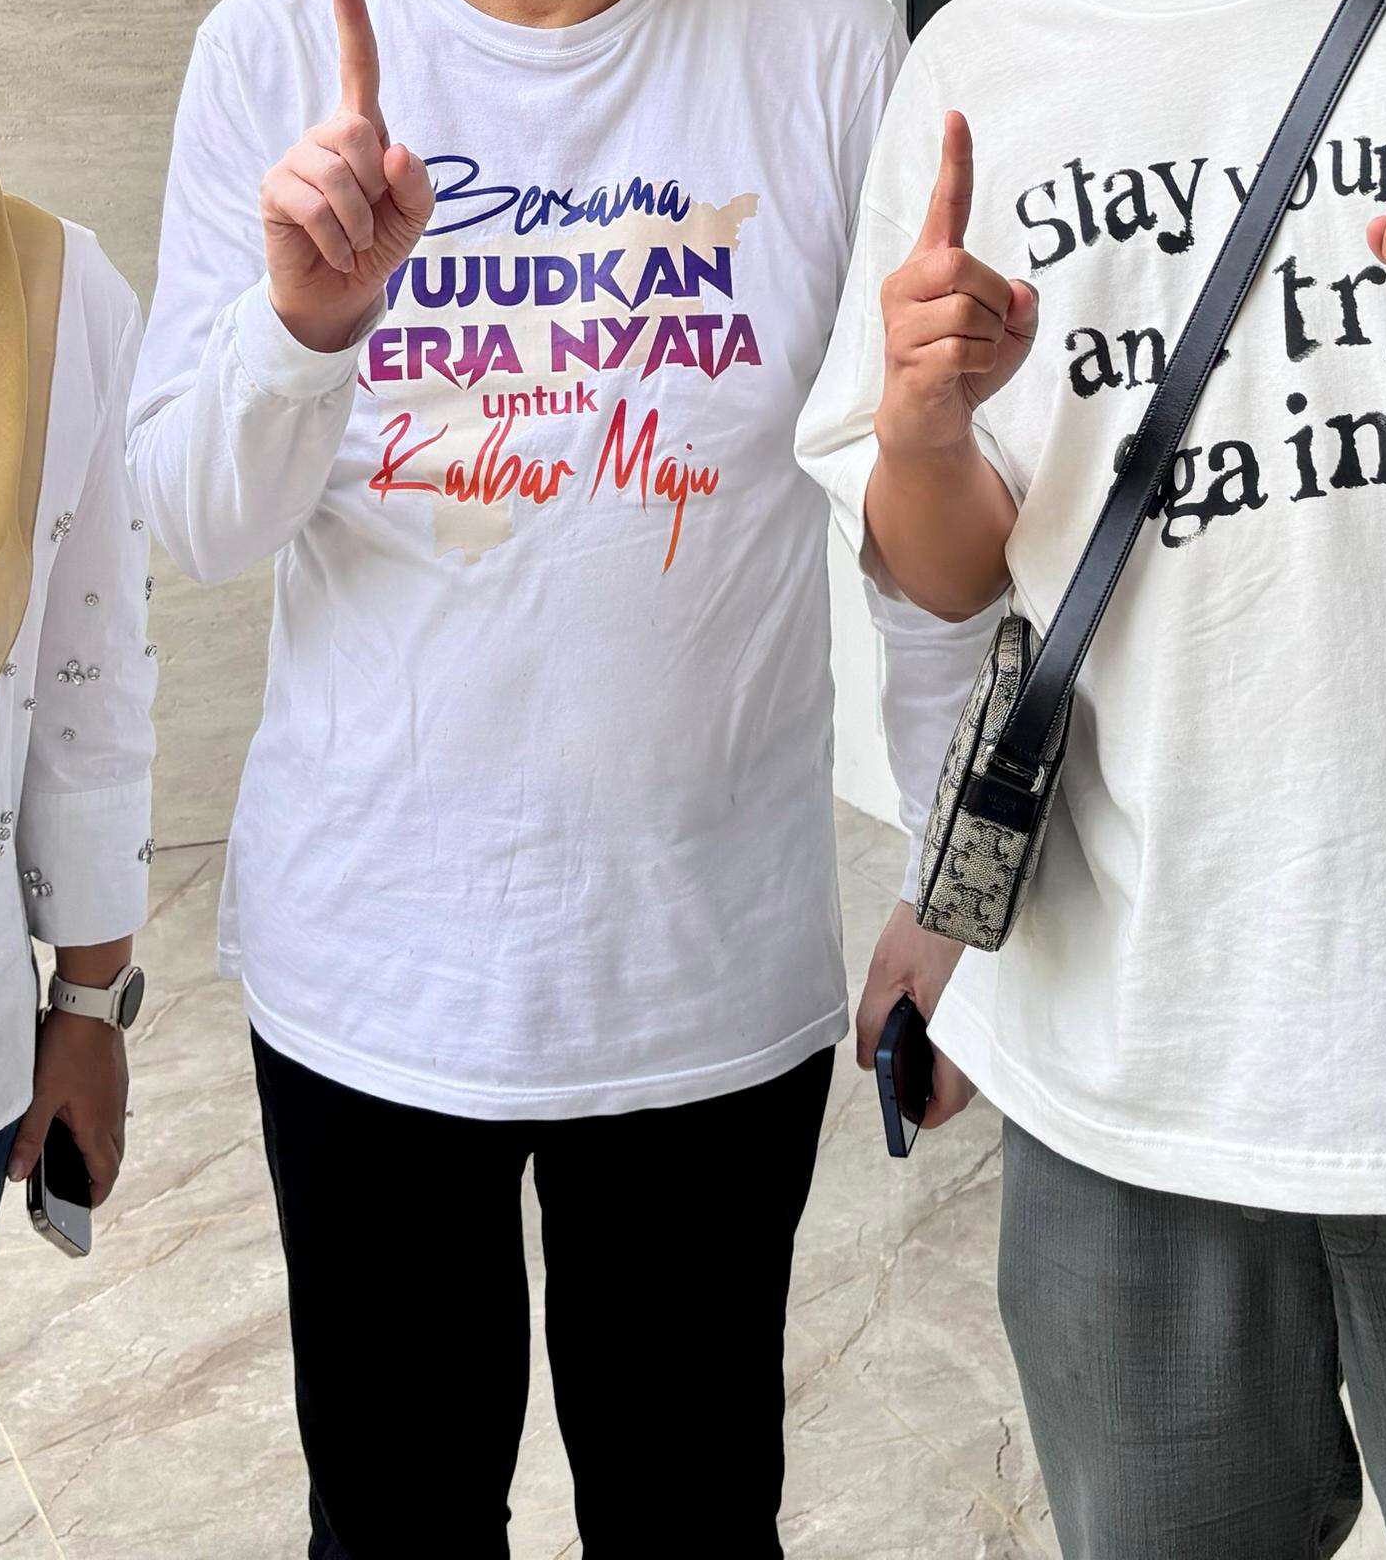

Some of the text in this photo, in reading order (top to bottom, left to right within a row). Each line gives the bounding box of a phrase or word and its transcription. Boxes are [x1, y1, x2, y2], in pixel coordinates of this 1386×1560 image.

[419, 155, 691, 237] Bersama
[357, 313, 763, 394] ERJA NYATA
[1064, 326, 1231, 399] an
[482, 381, 599, 419] untuk
[368, 398, 720, 576] Kalbar Maju
